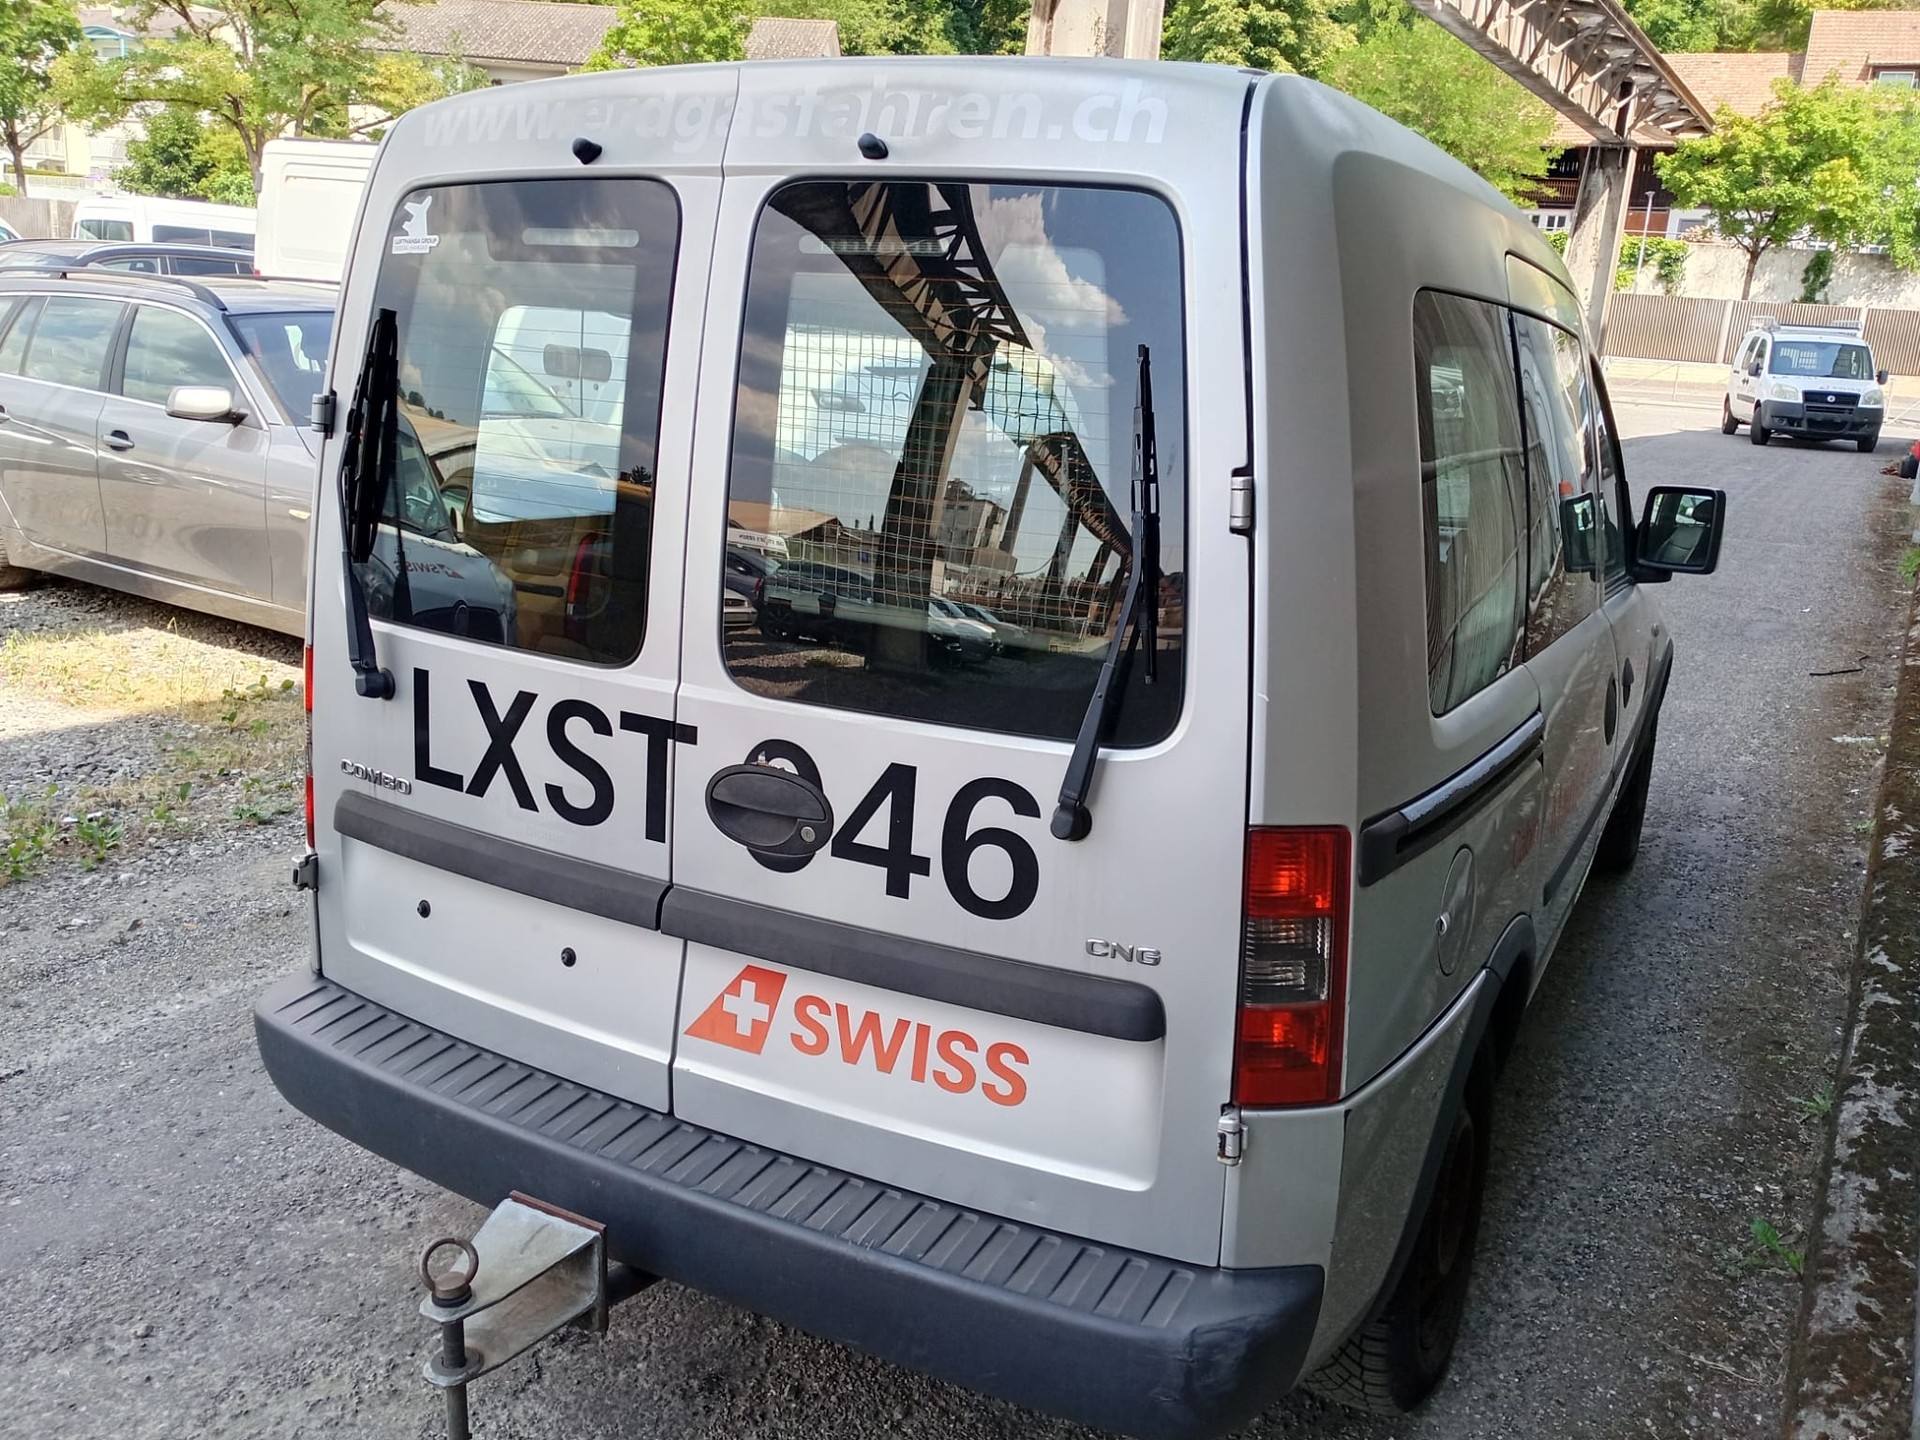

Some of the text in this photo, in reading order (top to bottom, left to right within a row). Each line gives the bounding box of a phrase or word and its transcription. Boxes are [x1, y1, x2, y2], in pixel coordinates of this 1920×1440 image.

[340, 758, 412, 795] COMBO
[412, 666, 698, 844] LXST
[1085, 938, 1162, 966] CNG
[789, 994, 1030, 1107] SWISS
